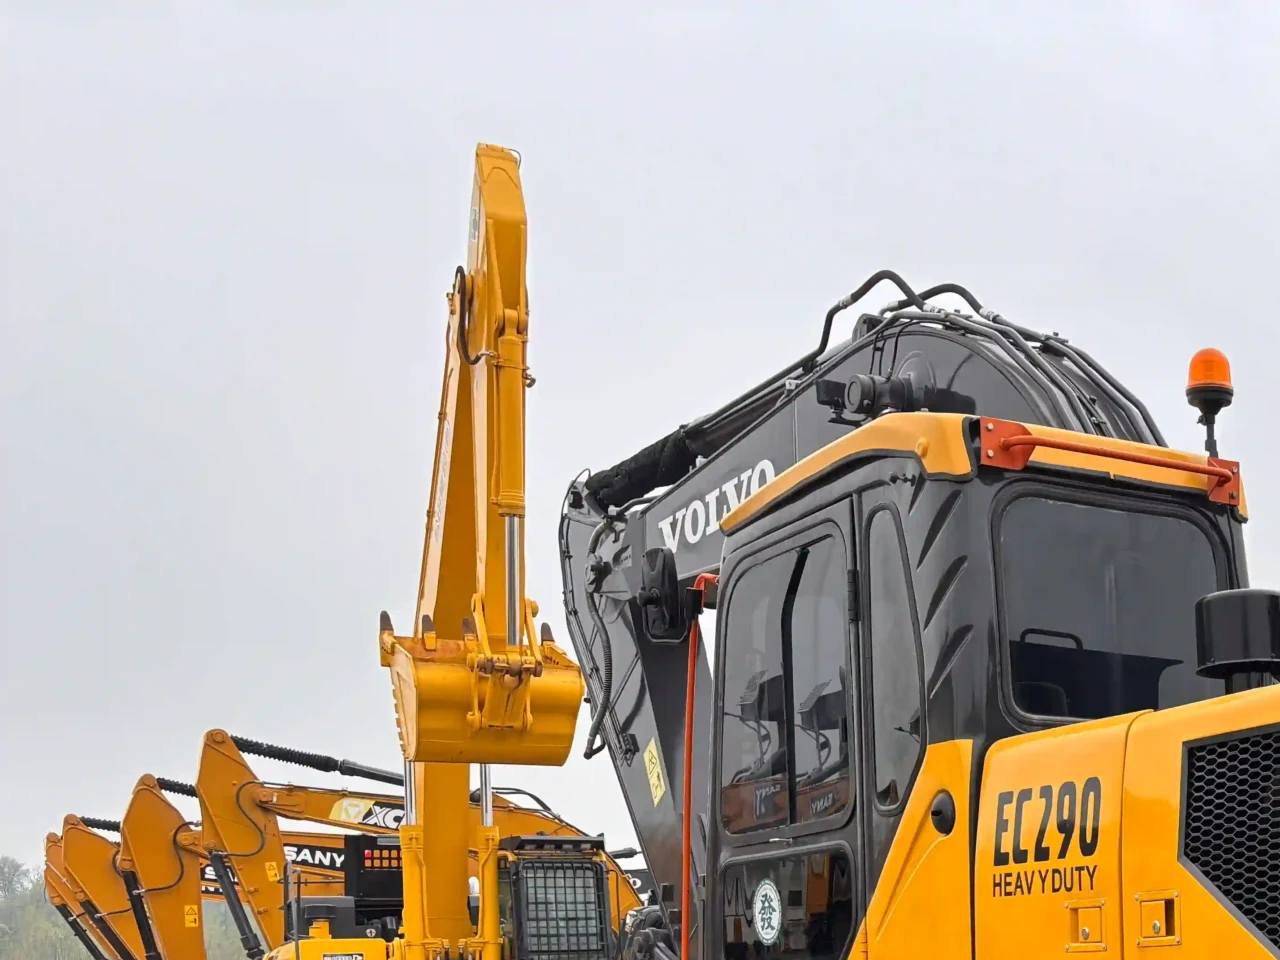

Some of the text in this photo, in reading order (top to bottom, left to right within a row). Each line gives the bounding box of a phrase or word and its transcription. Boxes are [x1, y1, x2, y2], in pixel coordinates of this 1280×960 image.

[658, 459, 776, 554] VOLVO
[362, 805, 405, 829] XC
[993, 776, 1102, 866] EC290
[283, 846, 345, 868] SANY
